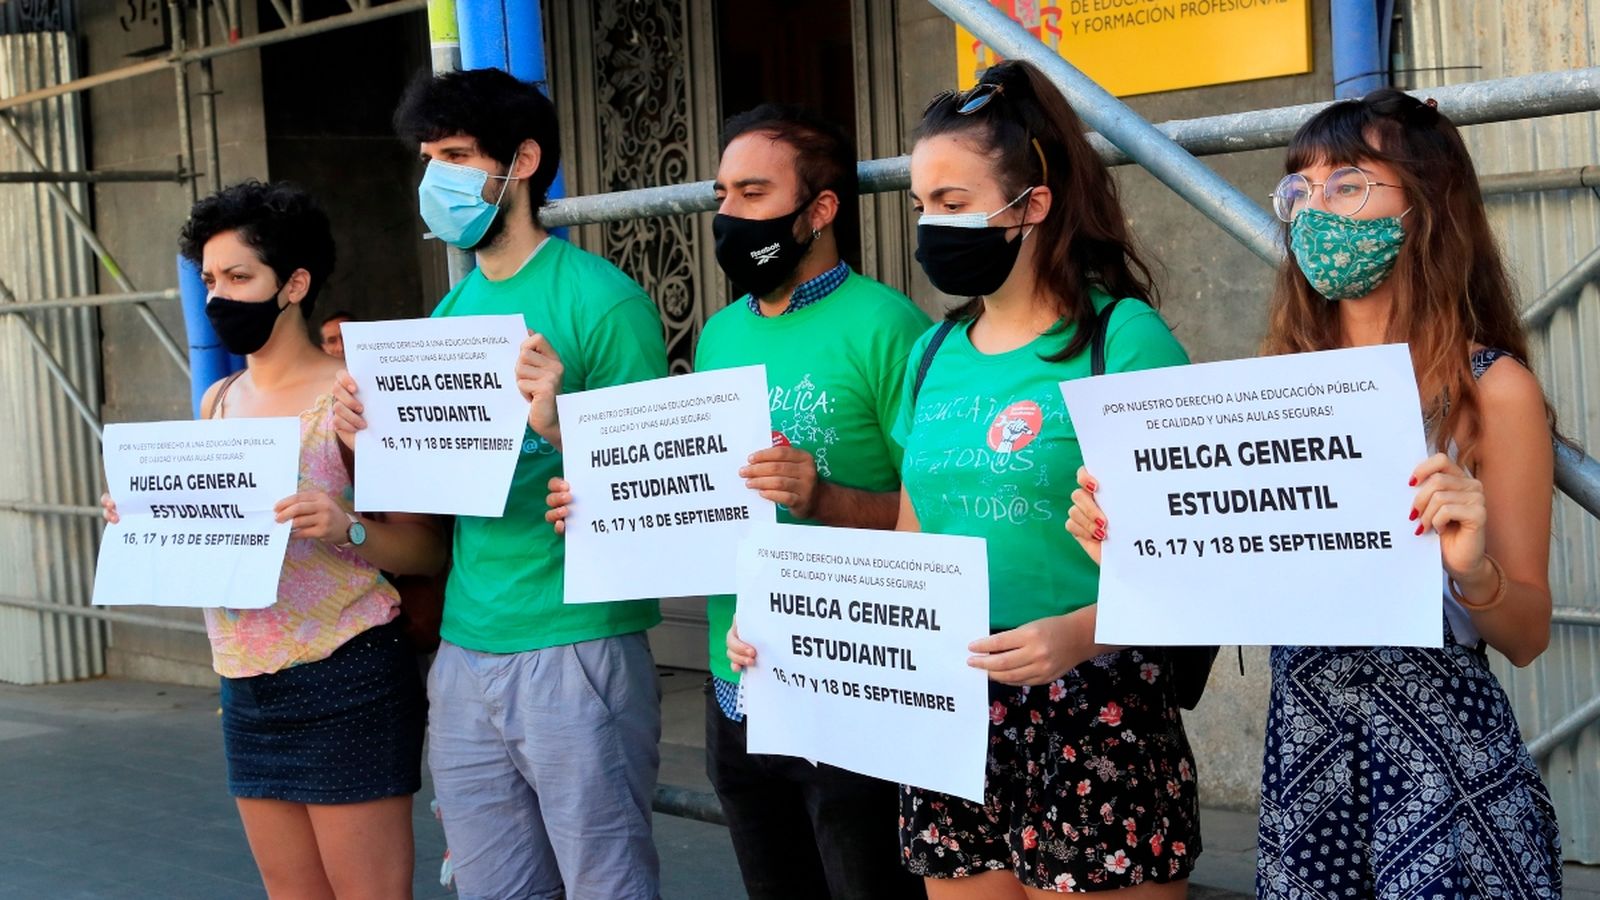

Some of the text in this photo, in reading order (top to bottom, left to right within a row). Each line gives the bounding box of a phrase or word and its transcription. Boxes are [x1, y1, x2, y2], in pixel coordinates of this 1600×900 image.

[1071, 0, 1089, 15] DE
[1071, 21, 1080, 35] Y
[1084, 5, 1175, 34] FORMACIÓN
[376, 372, 502, 391] HUELGA GENERAL
[1127, 399, 1174, 412] NUESTRO
[1175, 394, 1224, 409] DERECHO
[1226, 392, 1234, 403] A
[1235, 390, 1259, 403] UNA
[1261, 383, 1325, 401] EDUCACIÓN
[398, 406, 491, 422] ESTUDIANTIL
[1146, 419, 1160, 430] DE
[1162, 415, 1205, 429] CALIDAD
[1207, 414, 1214, 426] Y
[1216, 413, 1244, 425] UNAS
[1246, 410, 1280, 423] AULAS
[382, 437, 398, 451] 16,
[400, 437, 412, 449] 17
[415, 439, 421, 451] y
[424, 438, 437, 450] 18
[440, 438, 452, 450] DE
[455, 438, 513, 451] SEPTIEMBRE
[591, 434, 727, 468] HUELGA GENERAL
[1134, 435, 1362, 472] HUELGA GENERAL
[130, 472, 257, 492] HUELGA GENERAL
[611, 473, 715, 501] ESTUDIANTIL
[151, 504, 244, 519] ESTUDIANTIL
[958, 493, 1054, 526] TOD@S
[1167, 485, 1338, 516] ESTUDIANTIL
[591, 506, 749, 534] 16, 17 y 18 DE SEPTIEMBRE
[123, 533, 270, 547] 16, 17 y 18 DE SEPTIEMBRE
[1134, 530, 1392, 558] 16, 17 y 18 DE SEPTIEMBRE
[770, 550, 804, 562] NUESTRO
[806, 553, 844, 565] DERECHO
[845, 556, 851, 565] A
[853, 558, 871, 567] UNA
[873, 558, 922, 572] EDUCACIÓN
[781, 569, 791, 578] DE
[792, 570, 826, 581] CALIDAD
[827, 573, 833, 581] Y
[835, 574, 858, 584] UNAS
[859, 576, 885, 587] AULAS
[770, 592, 941, 631] HUELGA GENERAL
[792, 635, 917, 671] ESTUDIANTIL
[773, 667, 956, 712] 16, 17 y 18 DE SEPTIEMBRE
